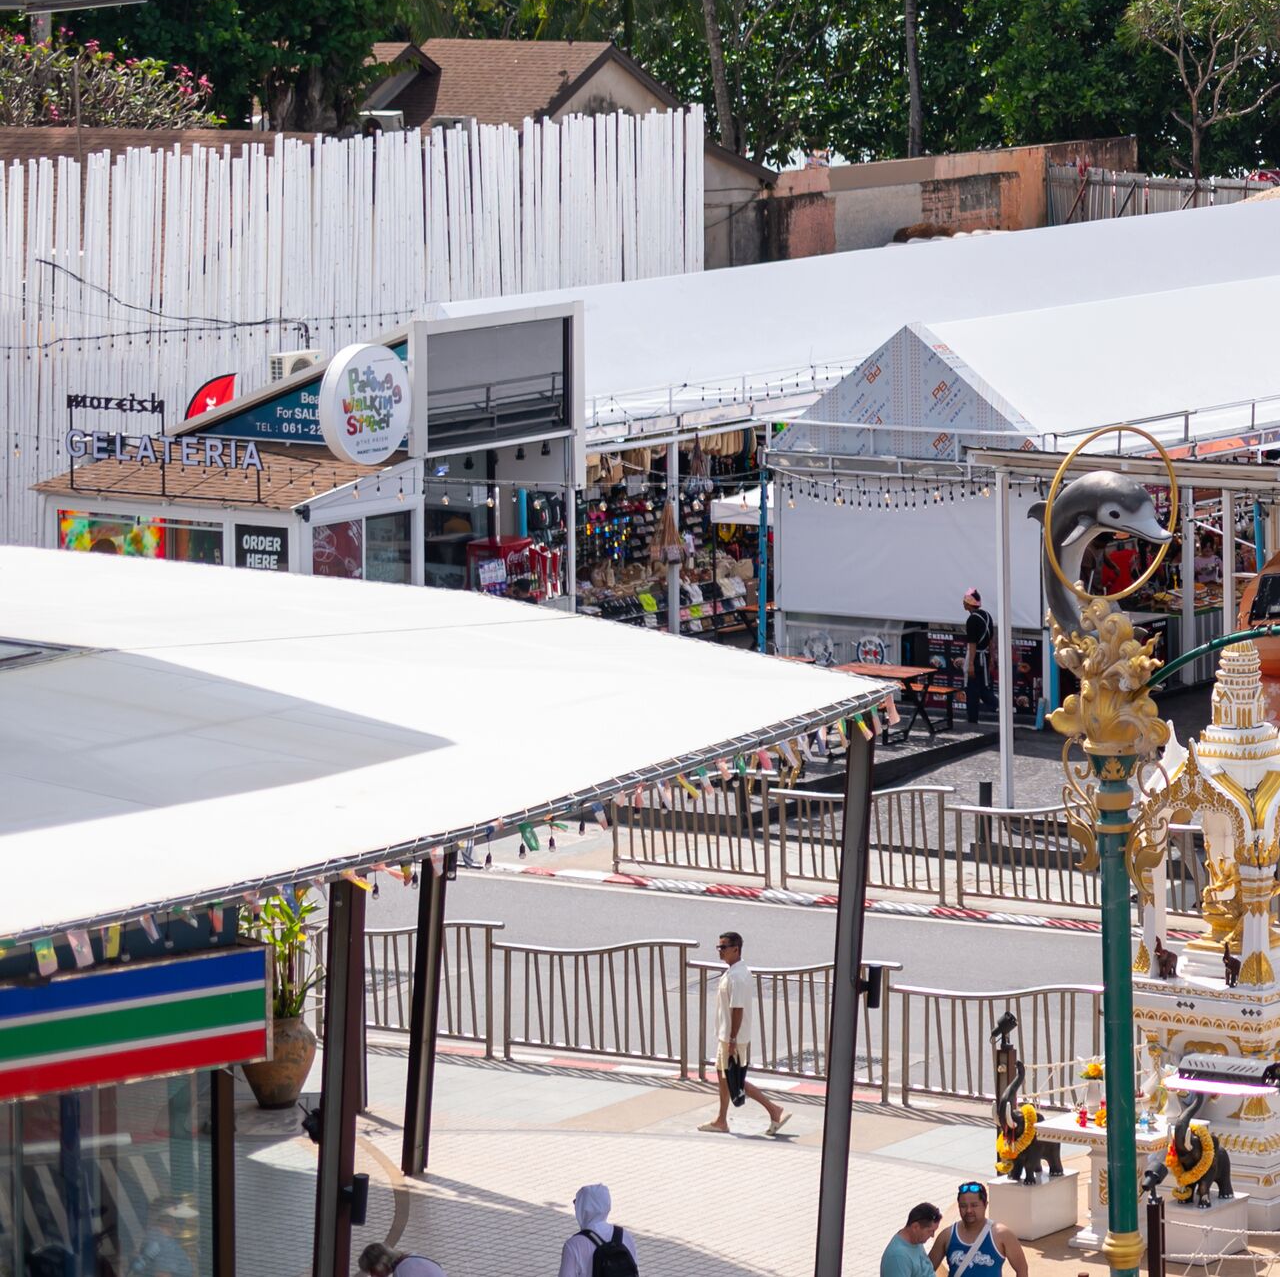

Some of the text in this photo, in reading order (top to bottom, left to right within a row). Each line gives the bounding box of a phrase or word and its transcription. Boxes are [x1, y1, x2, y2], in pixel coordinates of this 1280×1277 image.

[301, 392, 320, 405] Bea
[276, 406, 293, 419] For
[255, 422, 272, 432] TEL
[282, 422, 323, 435] 061-22
[66, 429, 264, 471] GELATERIA
[243, 534, 282, 552] ORDER
[246, 554, 278, 570] HERE
